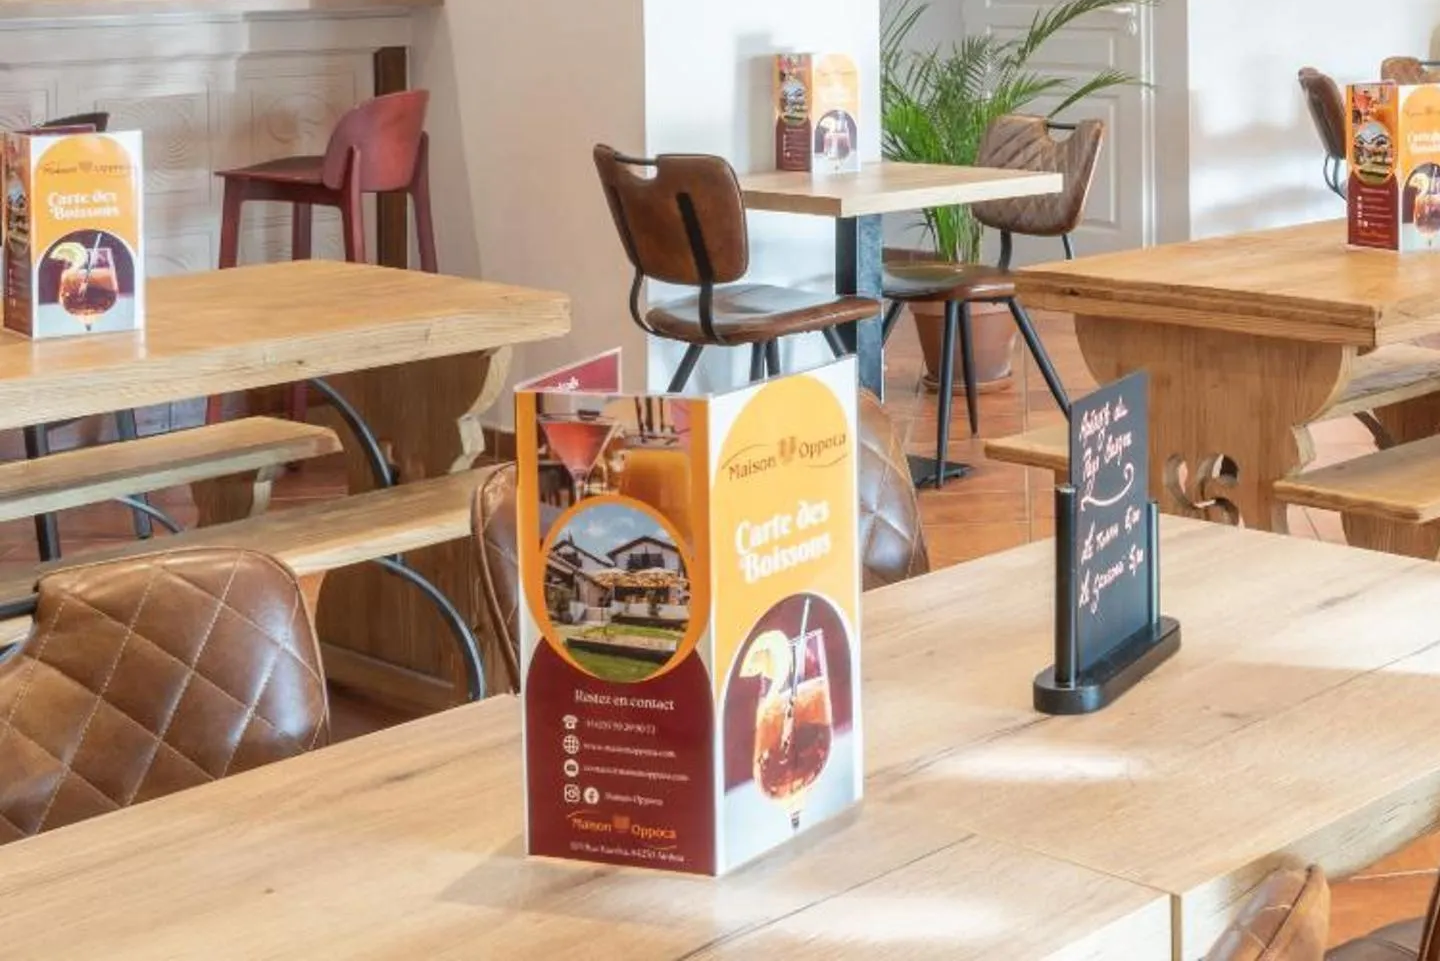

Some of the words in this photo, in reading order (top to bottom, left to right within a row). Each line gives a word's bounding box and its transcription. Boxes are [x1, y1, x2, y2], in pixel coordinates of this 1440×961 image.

[728, 455, 777, 481] Maison
[736, 515, 793, 556] Carte
[795, 498, 831, 530] des
[738, 531, 832, 584] Boissons
[575, 689, 612, 705] Restez
[613, 696, 629, 707] en
[630, 698, 676, 711] contact
[572, 818, 612, 833] Maison
